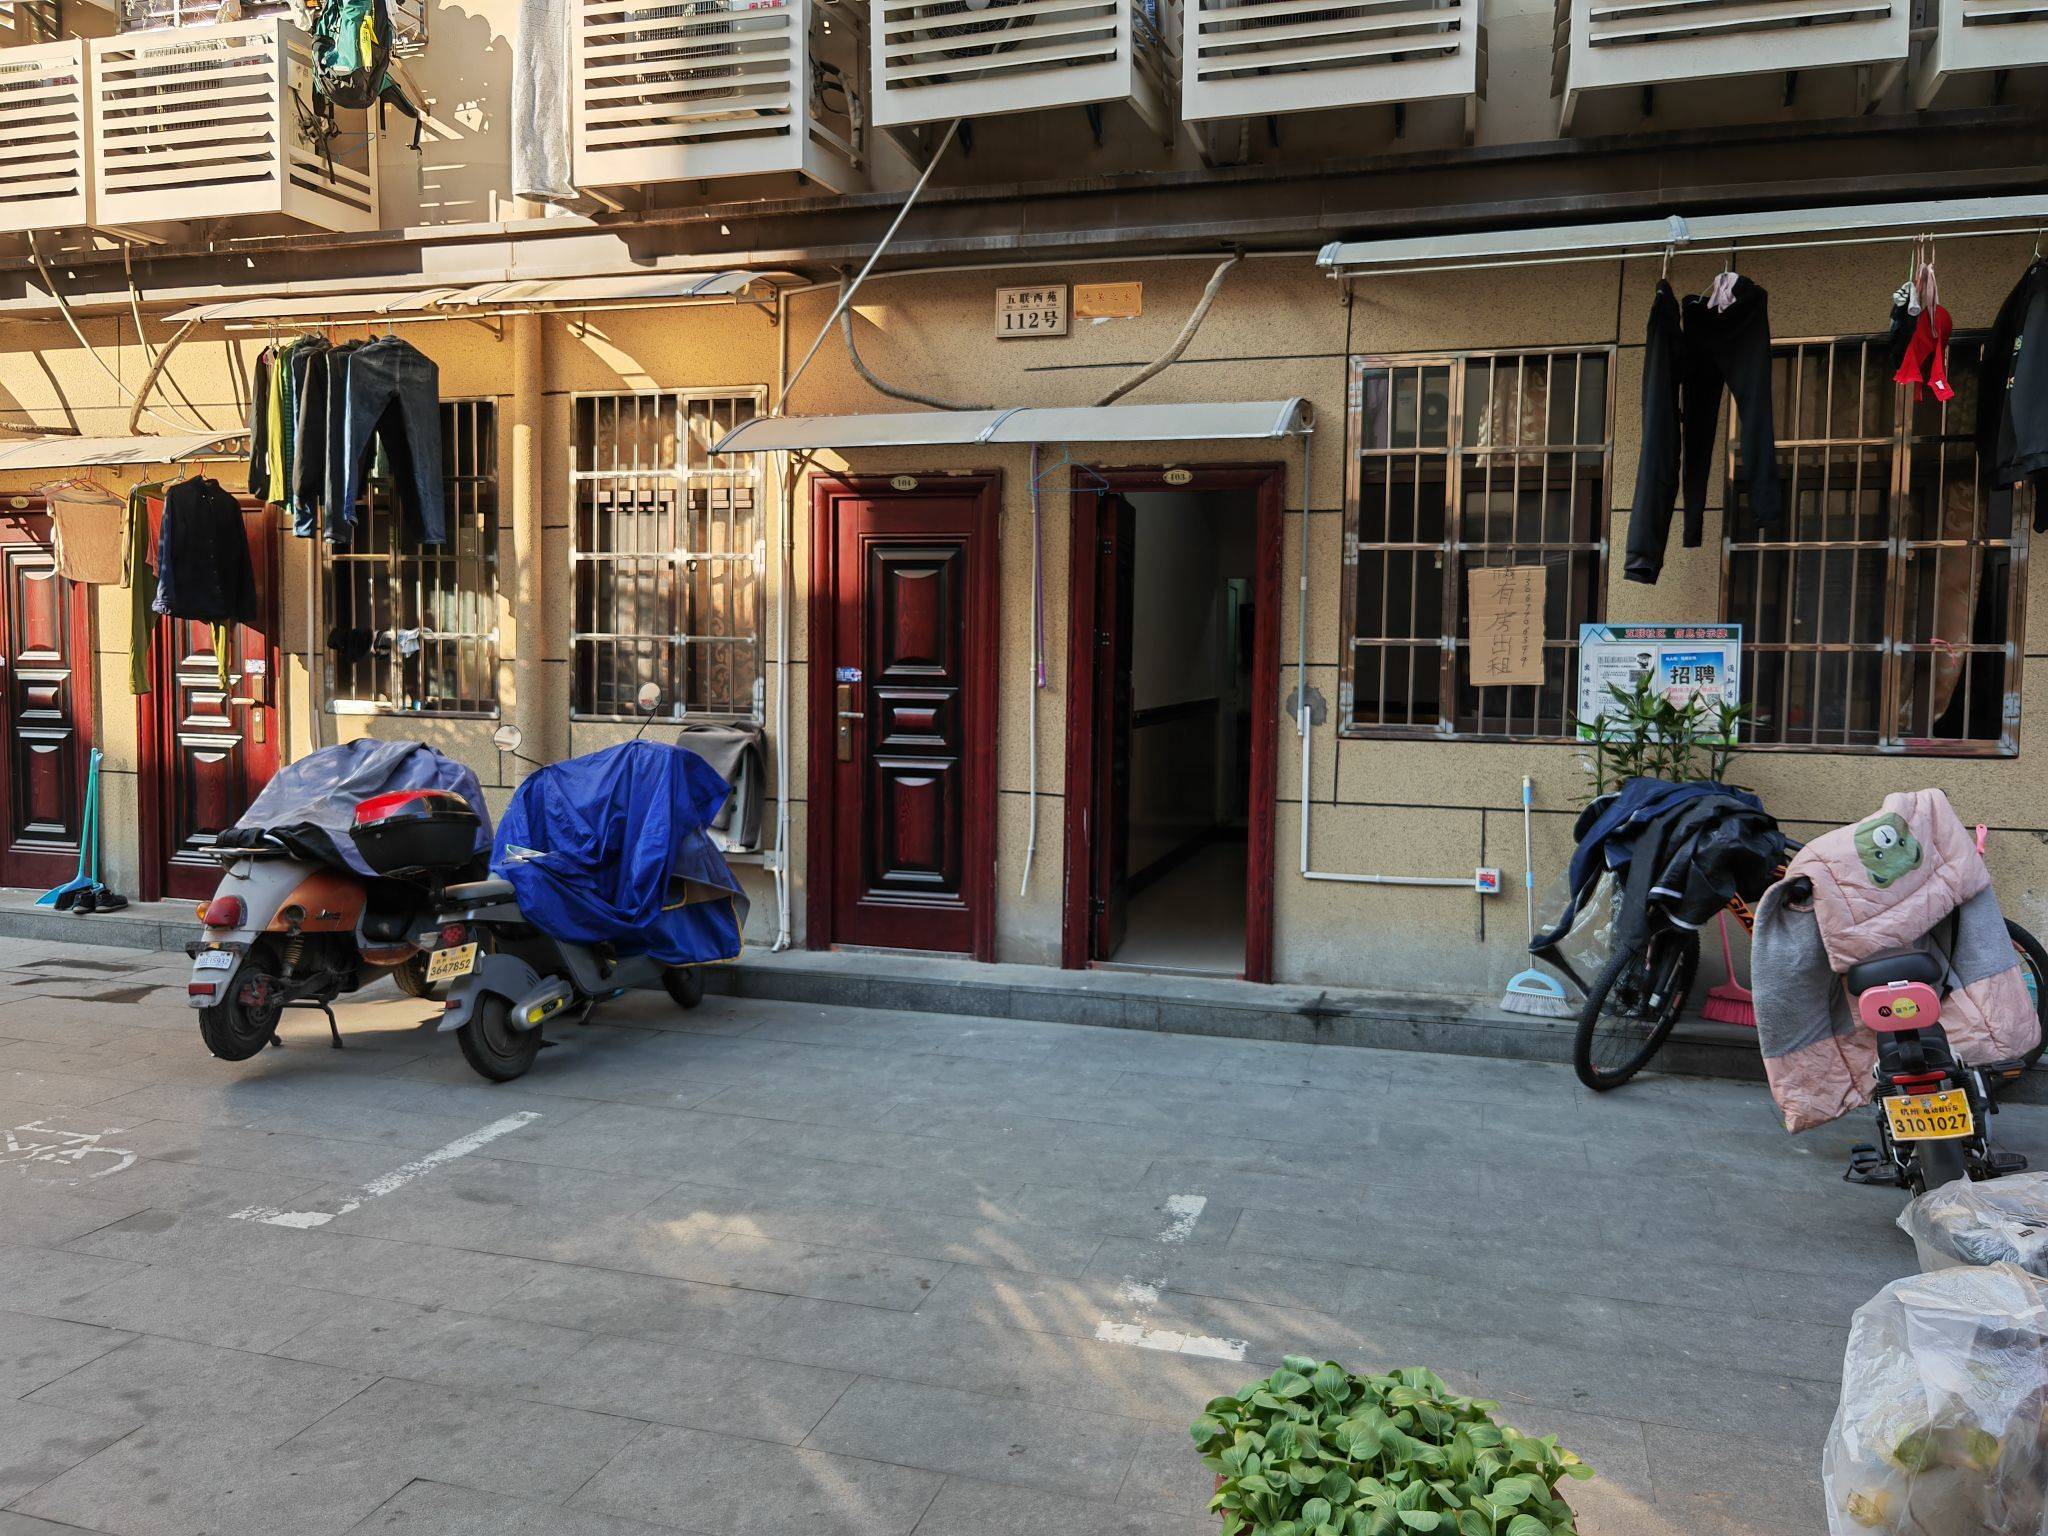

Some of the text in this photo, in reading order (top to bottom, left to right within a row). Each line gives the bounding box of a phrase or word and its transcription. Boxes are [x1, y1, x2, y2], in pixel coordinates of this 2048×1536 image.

[1006, 291, 1057, 305] 五联西苑
[1005, 310, 1058, 330] 112号
[1485, 579, 1517, 677] 有房出租
[1669, 664, 1716, 685] 招聘
[430, 958, 471, 976] 3647852
[1900, 1104, 1959, 1116] 杭州 电动自行车
[1894, 1113, 1967, 1133] 3101027
